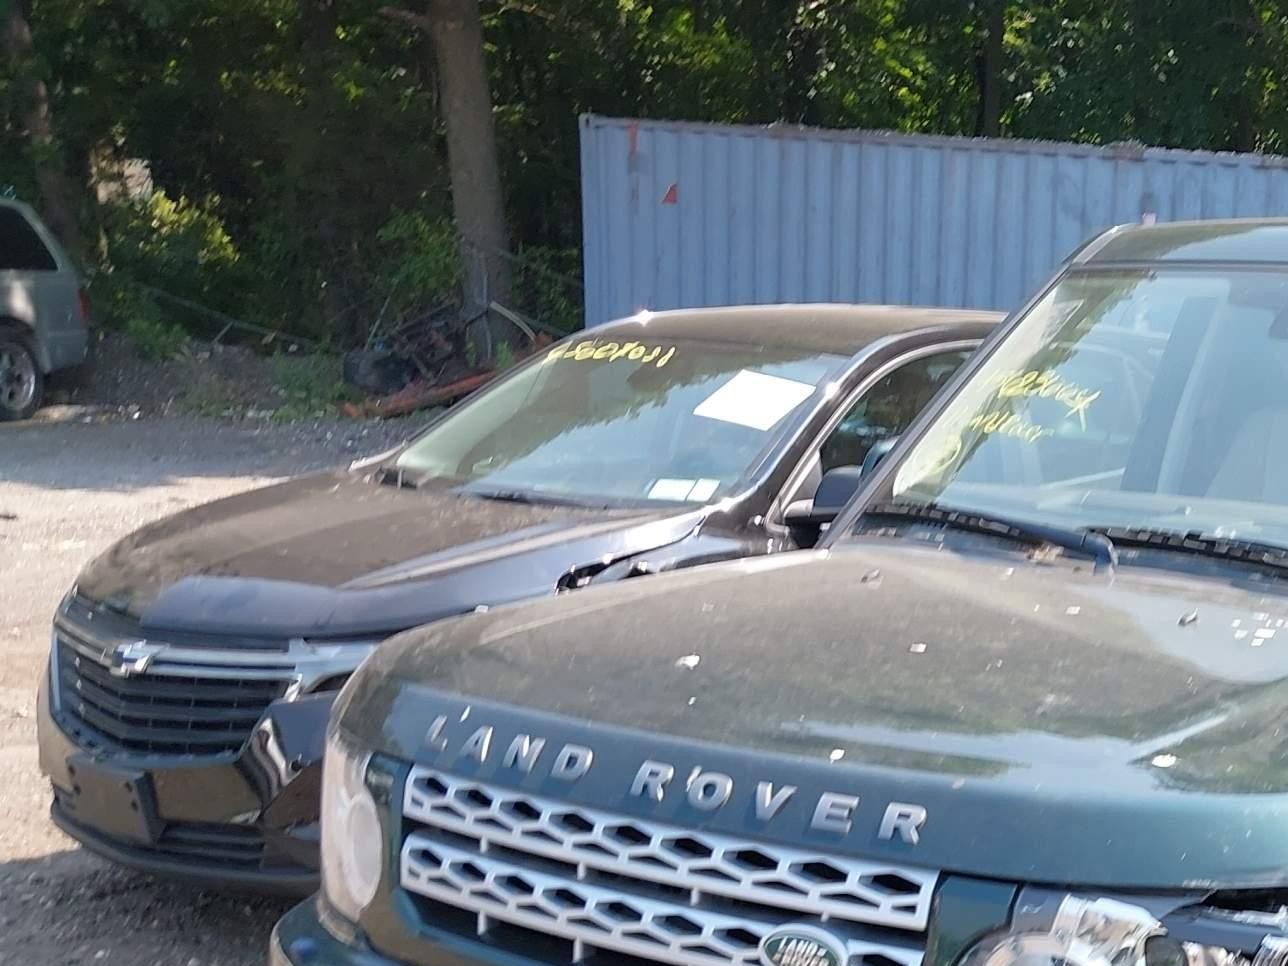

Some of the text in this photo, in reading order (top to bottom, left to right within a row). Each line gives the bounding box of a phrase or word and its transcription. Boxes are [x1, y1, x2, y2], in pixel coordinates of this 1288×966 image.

[425, 714, 928, 845] LAND ROVER
[777, 935, 819, 957] LAND
